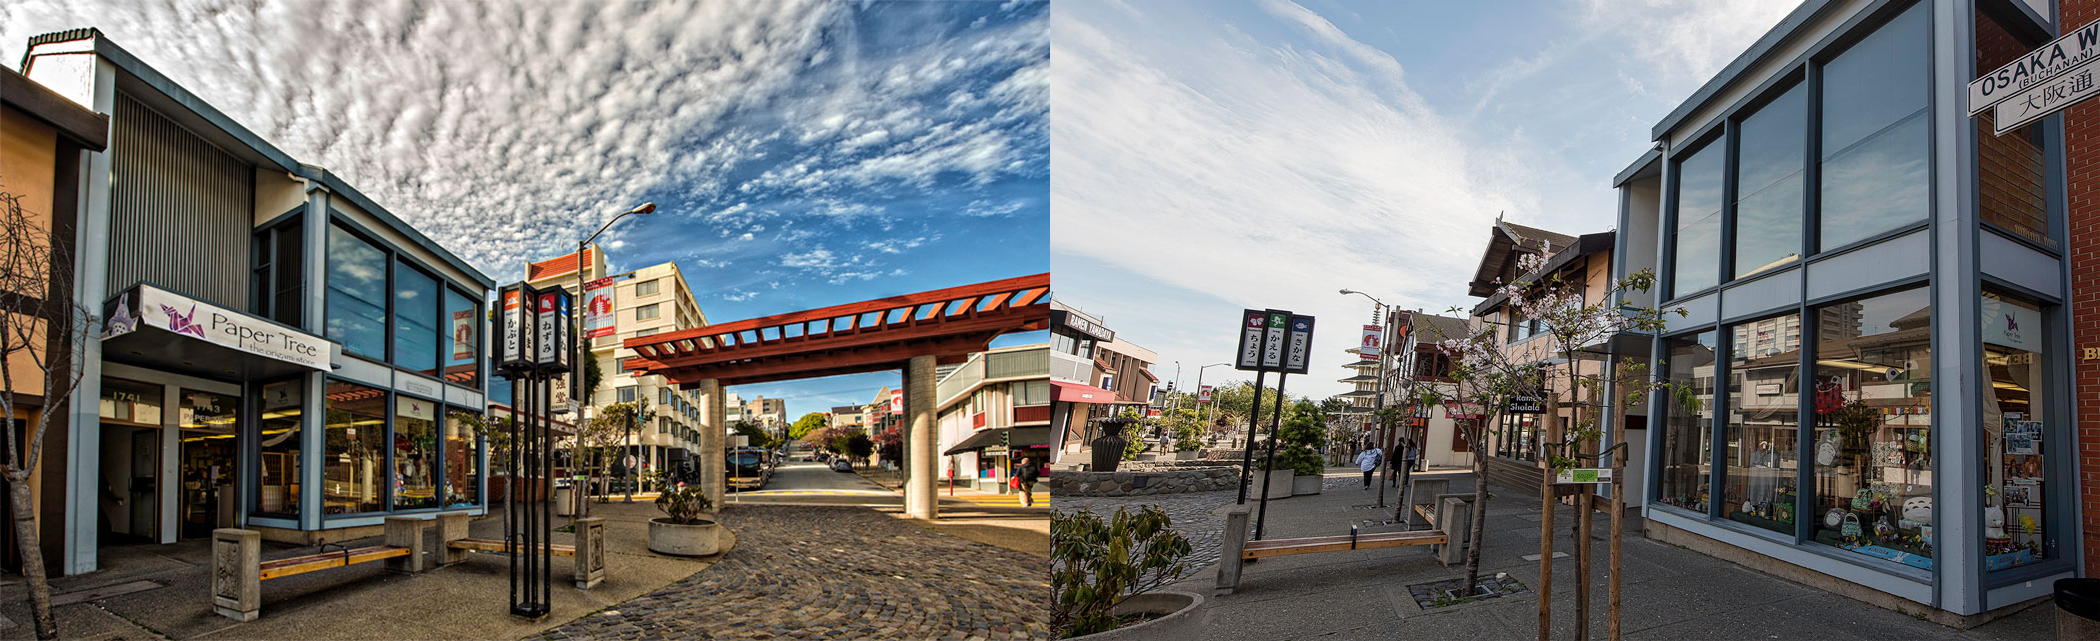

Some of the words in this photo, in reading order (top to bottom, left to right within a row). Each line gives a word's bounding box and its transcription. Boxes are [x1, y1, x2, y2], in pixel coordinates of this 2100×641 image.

[1982, 43, 2067, 96] OSAKA
[2078, 23, 2100, 51] W
[2018, 48, 2093, 88] (BUCHANAN)
[2019, 69, 2100, 117] 大阪通
[212, 313, 274, 348] Paper
[279, 333, 317, 357] Tree
[507, 318, 517, 350] かぶと
[1070, 314, 1088, 332] RAMEN
[542, 320, 552, 353] ねずみ
[1248, 333, 1258, 358] ちょう
[1268, 334, 1280, 360] かえる
[249, 342, 265, 354] the
[265, 348, 295, 361] origami
[296, 355, 316, 365] store
[1291, 338, 1303, 362] さかな
[2084, 347, 2100, 360] B
[113, 391, 140, 402] 1741
[555, 372, 566, 404] 強堂
[183, 413, 211, 422] PAPER
[196, 403, 220, 414] 1743
[1510, 403, 1540, 411] Shalala
